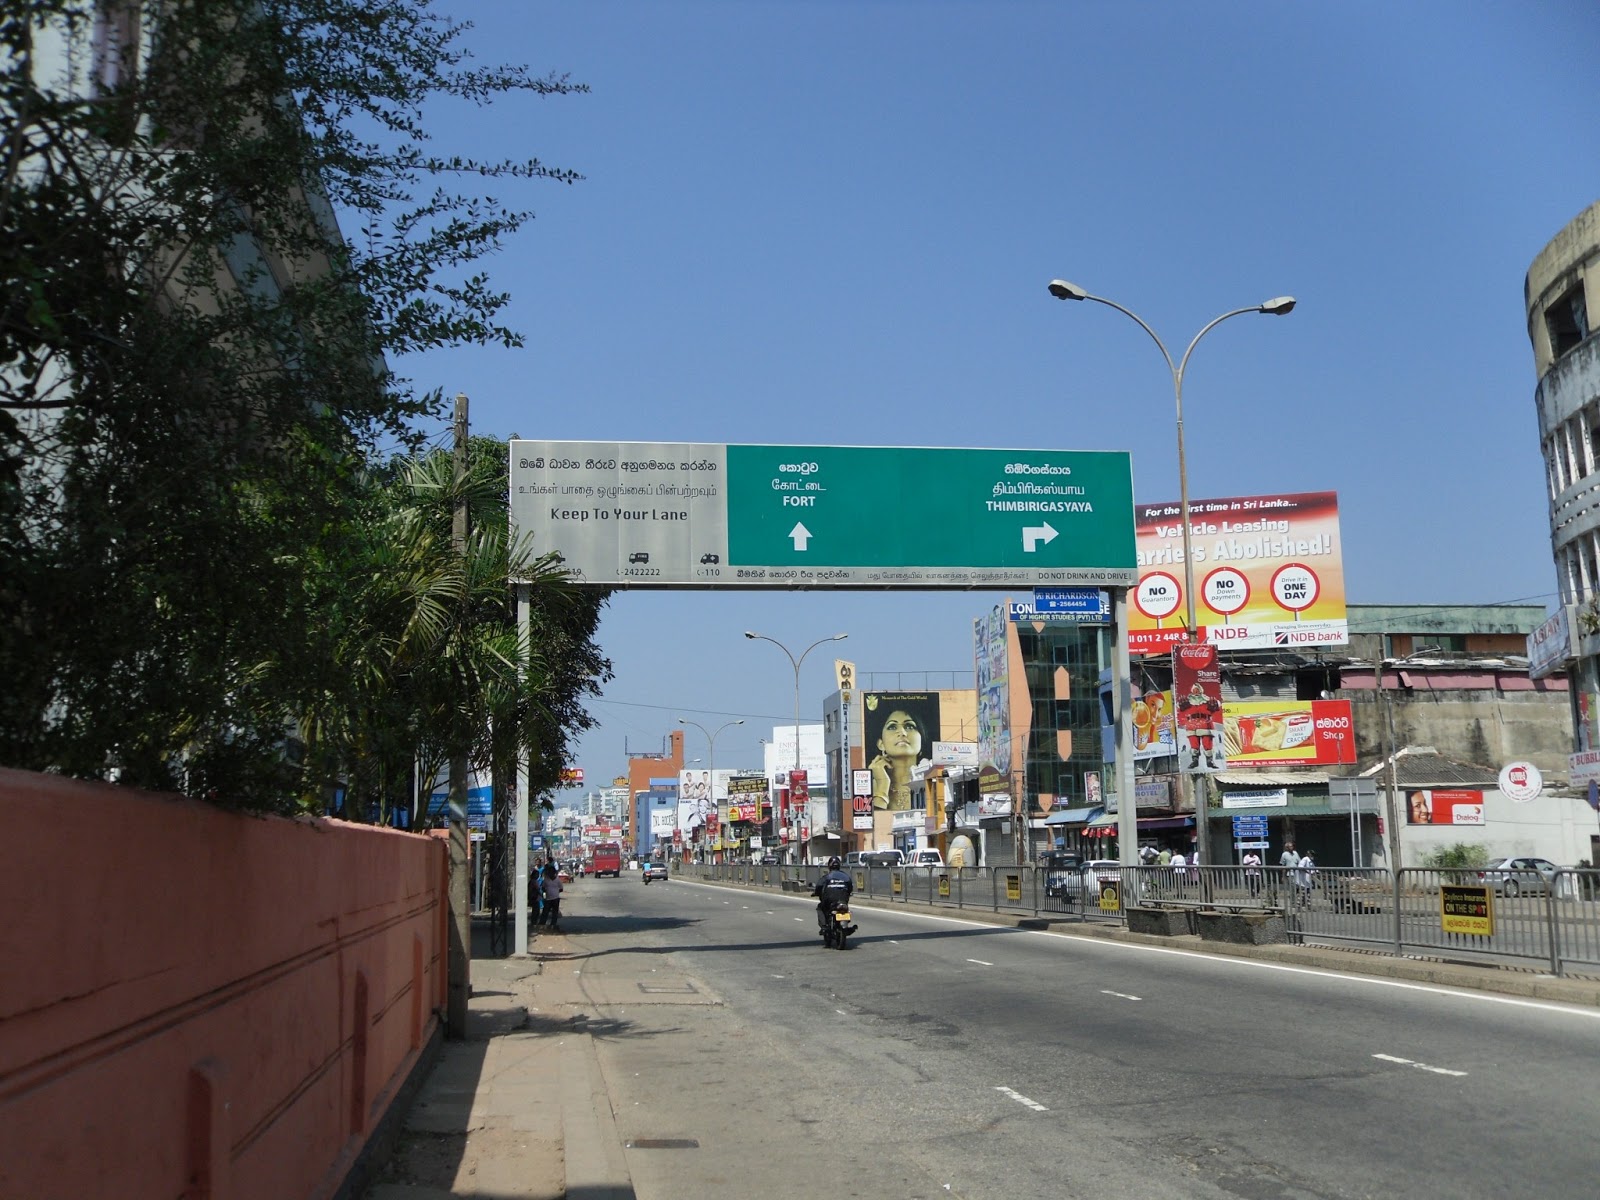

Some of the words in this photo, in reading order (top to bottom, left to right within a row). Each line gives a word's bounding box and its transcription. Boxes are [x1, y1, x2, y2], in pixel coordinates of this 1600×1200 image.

[519, 457, 545, 470] ඔබේ
[549, 458, 581, 470] ධාවන
[620, 459, 676, 473] අනුගමනය
[680, 459, 717, 472] කරන්න
[778, 462, 819, 475] කොටුව
[771, 478, 828, 491] கோட்டை
[561, 485, 594, 498] பாதை
[782, 495, 816, 507] FORT
[985, 500, 1093, 513] THIMBIRIGASYAYA
[551, 508, 589, 522] Keep
[592, 508, 609, 520] To
[613, 508, 649, 520] Your
[652, 508, 688, 521] Lane
[1145, 508, 1162, 518] For
[1164, 506, 1181, 516] the
[1187, 504, 1204, 513] irst
[1206, 502, 1229, 512] time
[1231, 501, 1241, 510] in
[1243, 500, 1258, 509] Sri
[1222, 518, 1290, 533] Leasing
[1137, 543, 1207, 567] arries
[1212, 533, 1333, 562] Abolished!
[1038, 572, 1050, 580] DO
[1050, 572, 1066, 580] NOT
[1067, 572, 1090, 580] DRINK
[1090, 572, 1106, 581] AND
[1216, 579, 1235, 589] NO
[1283, 582, 1307, 591] ONE
[1045, 592, 1098, 600] RICHARDSON
[1148, 587, 1168, 596] NO
[1211, 593, 1242, 602] payments
[1284, 591, 1307, 600] DAY
[1141, 595, 1176, 604] Guarantors
[1136, 633, 1154, 643] 011
[1155, 633, 1162, 642] 2
[1163, 632, 1181, 641] 448
[1213, 627, 1249, 641] NDB
[1290, 632, 1316, 643] NDB
[1317, 631, 1343, 642] bank
[1576, 752, 1600, 765] BUBBL
[1456, 814, 1479, 822] Dialog
[1446, 904, 1454, 912] ON
[1455, 904, 1468, 913] THE
